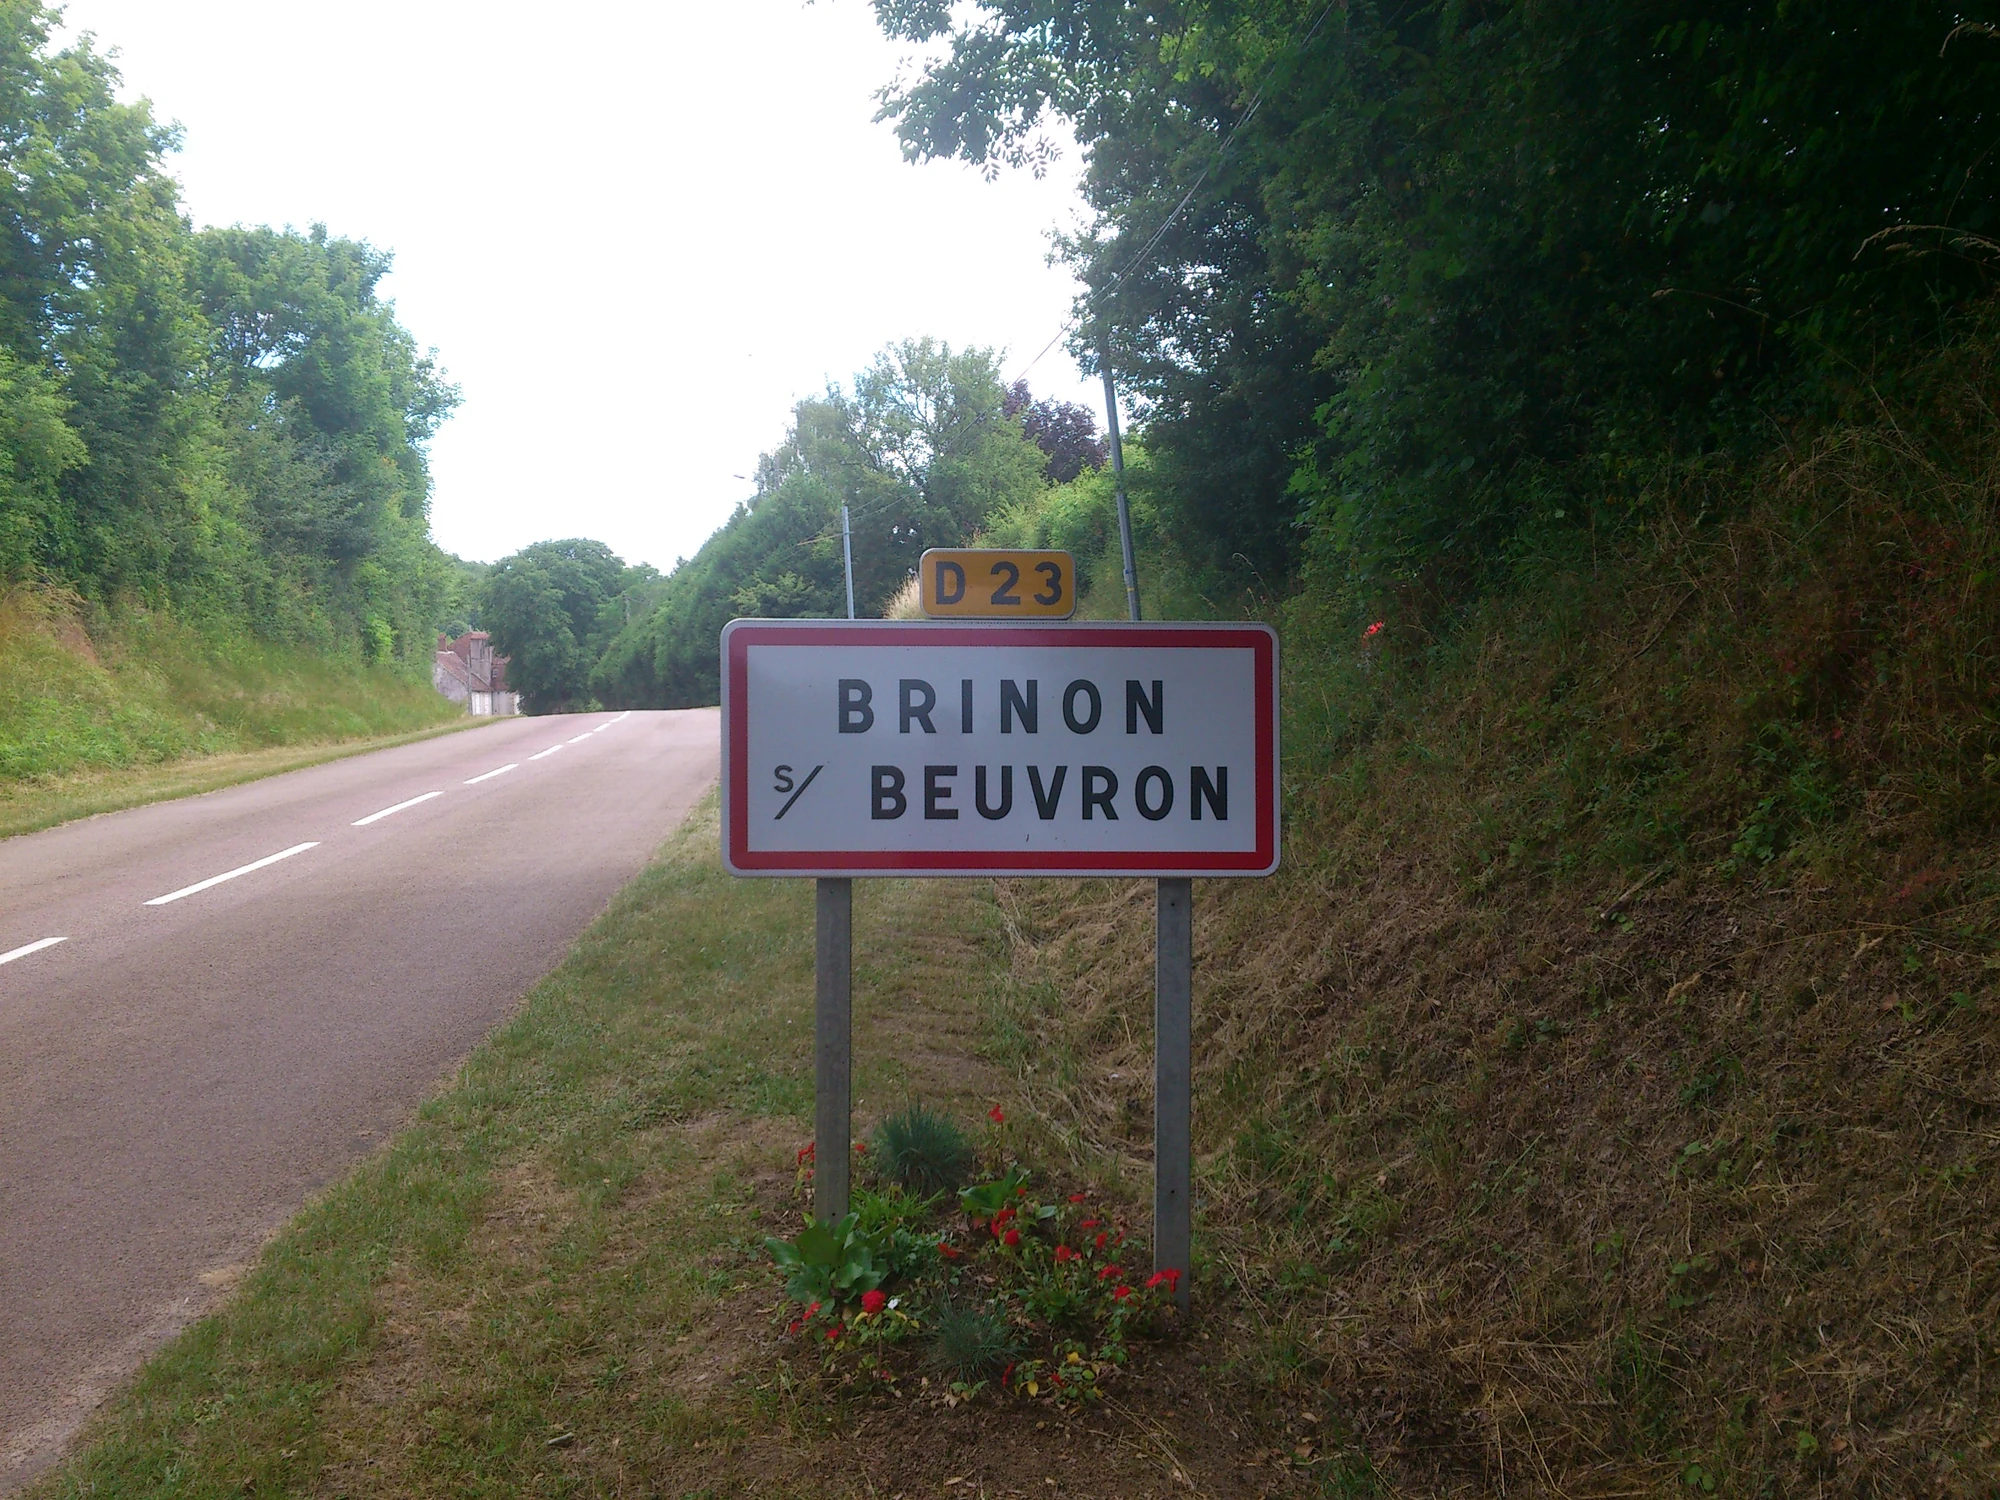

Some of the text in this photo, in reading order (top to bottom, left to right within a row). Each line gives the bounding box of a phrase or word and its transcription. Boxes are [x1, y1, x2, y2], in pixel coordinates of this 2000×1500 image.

[935, 561, 1063, 606] D 23
[838, 679, 1164, 735] BRINON
[871, 765, 1228, 821] BEUVRON
